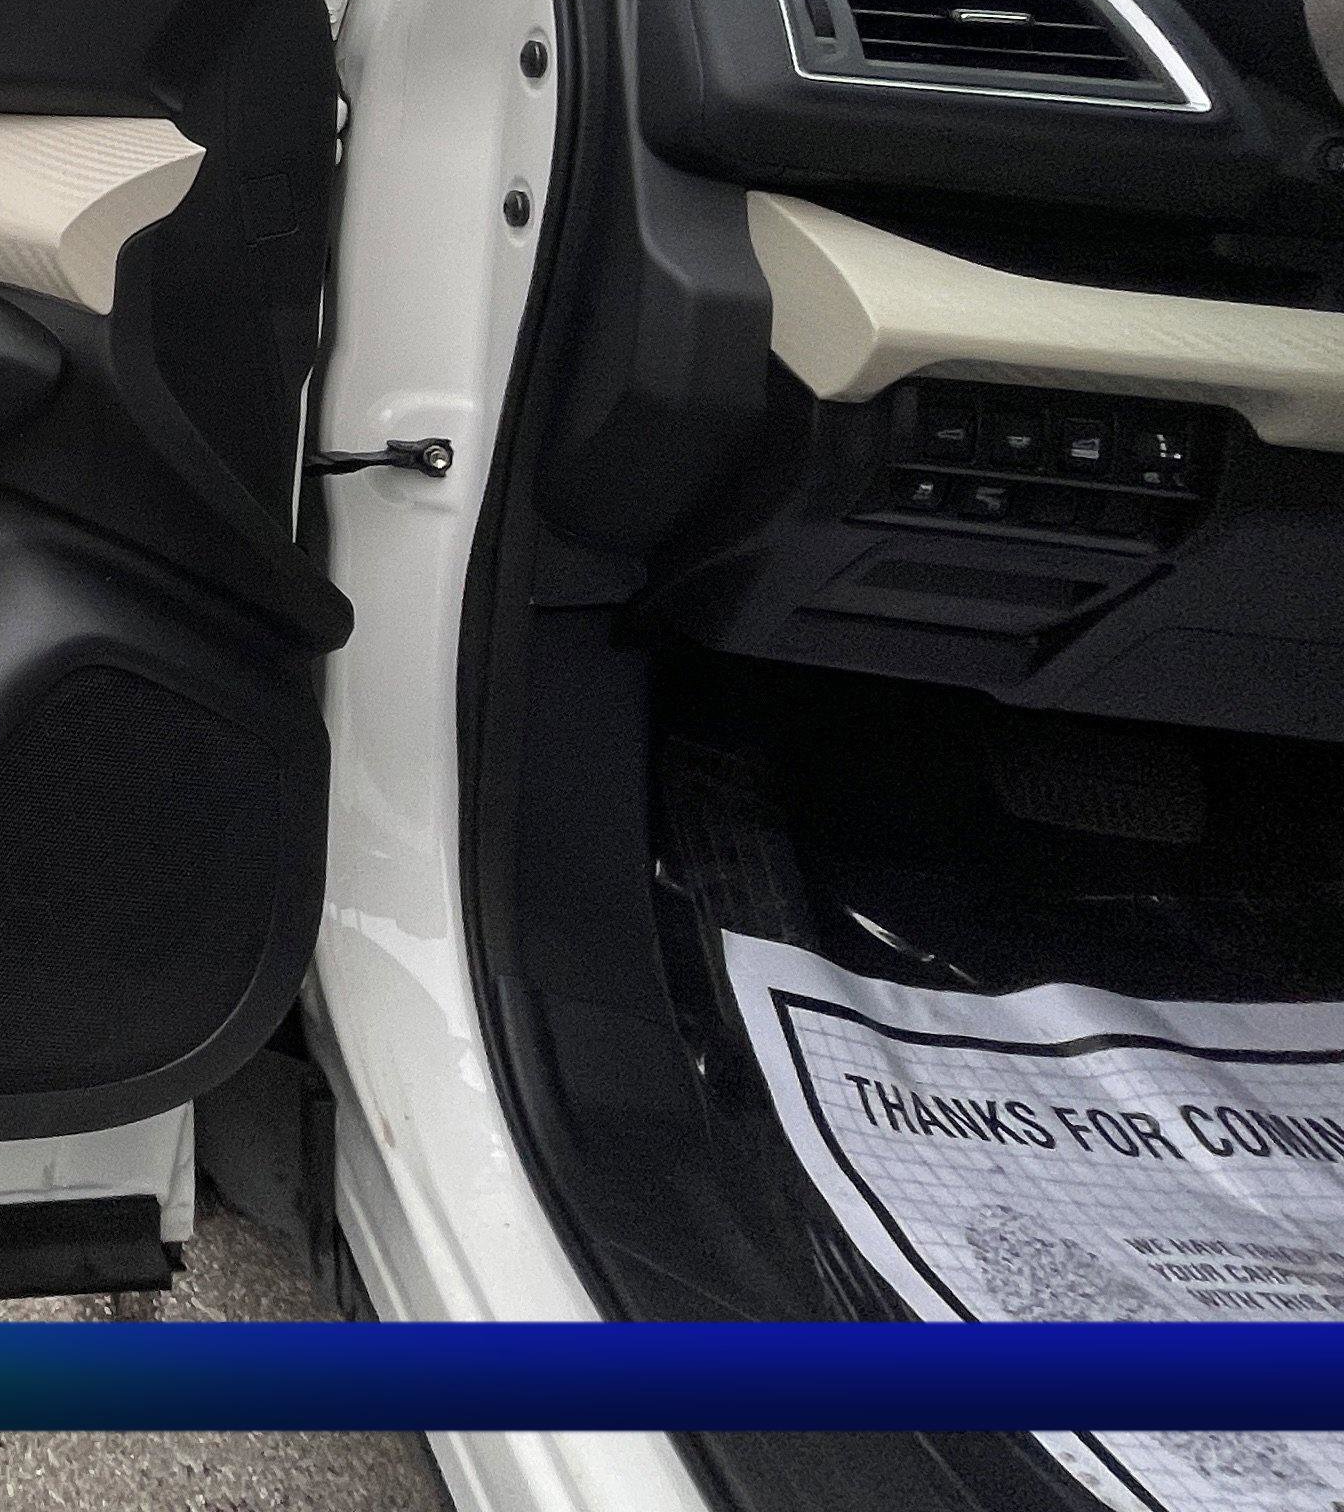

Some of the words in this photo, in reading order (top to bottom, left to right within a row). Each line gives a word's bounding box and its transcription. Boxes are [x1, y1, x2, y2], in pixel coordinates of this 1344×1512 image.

[844, 1073, 1056, 1150] THANKS
[1051, 1105, 1188, 1161] FOR
[1147, 1260, 1228, 1283] YOUR
[1185, 1286, 1266, 1311] WITH
